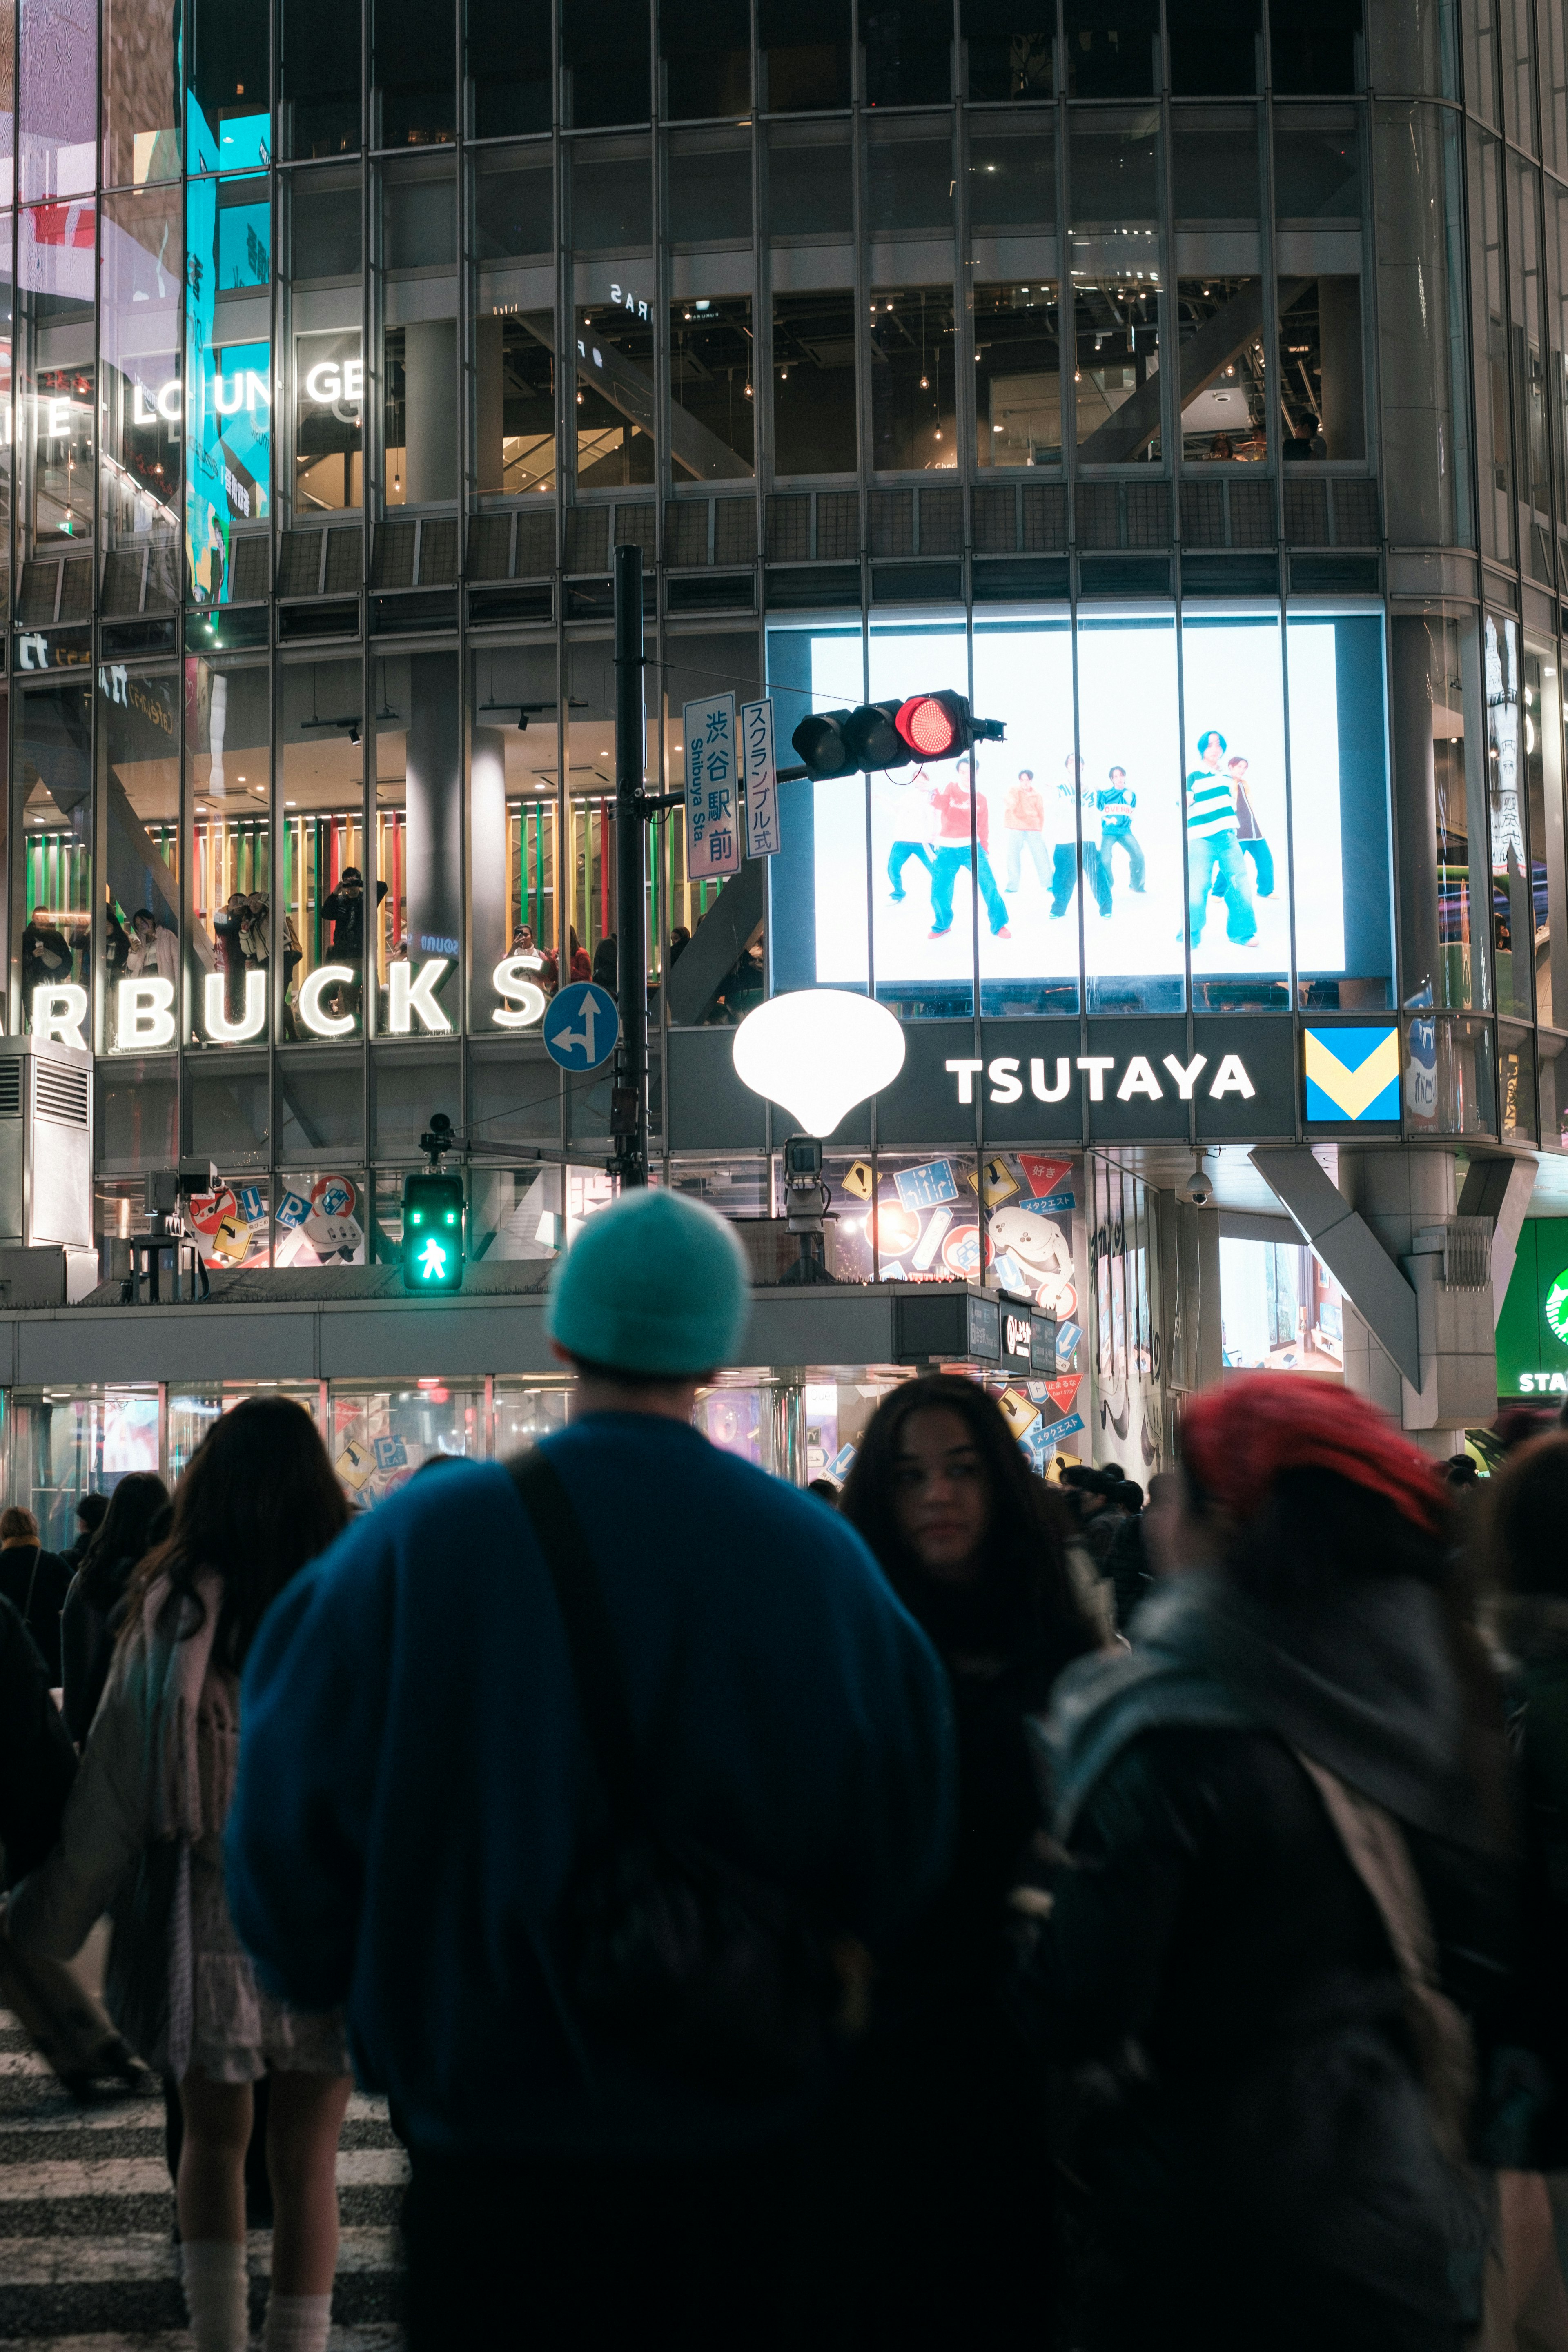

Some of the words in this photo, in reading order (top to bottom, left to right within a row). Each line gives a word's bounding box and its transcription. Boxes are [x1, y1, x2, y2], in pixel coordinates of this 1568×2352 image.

[134, 359, 363, 425] LOUNGE
[935, 461, 958, 469] Chec
[690, 738, 704, 807] Shibuya
[706, 709, 732, 862] 渋谷駅前
[749, 707, 772, 851] スクランブル式
[693, 813, 705, 848] Sta.
[0, 956, 546, 1051] RBUCKS
[945, 1053, 1256, 1104] TSUTAYA
[1032, 1164, 1056, 1179] 好き
[1026, 1196, 1070, 1211] メタクエスト
[249, 1220, 268, 1231] 飛びこめ
[1048, 1379, 1077, 1390] 止まるな
[1519, 1372, 1568, 1392] STA
[1036, 1418, 1078, 1444] メタクエスト
